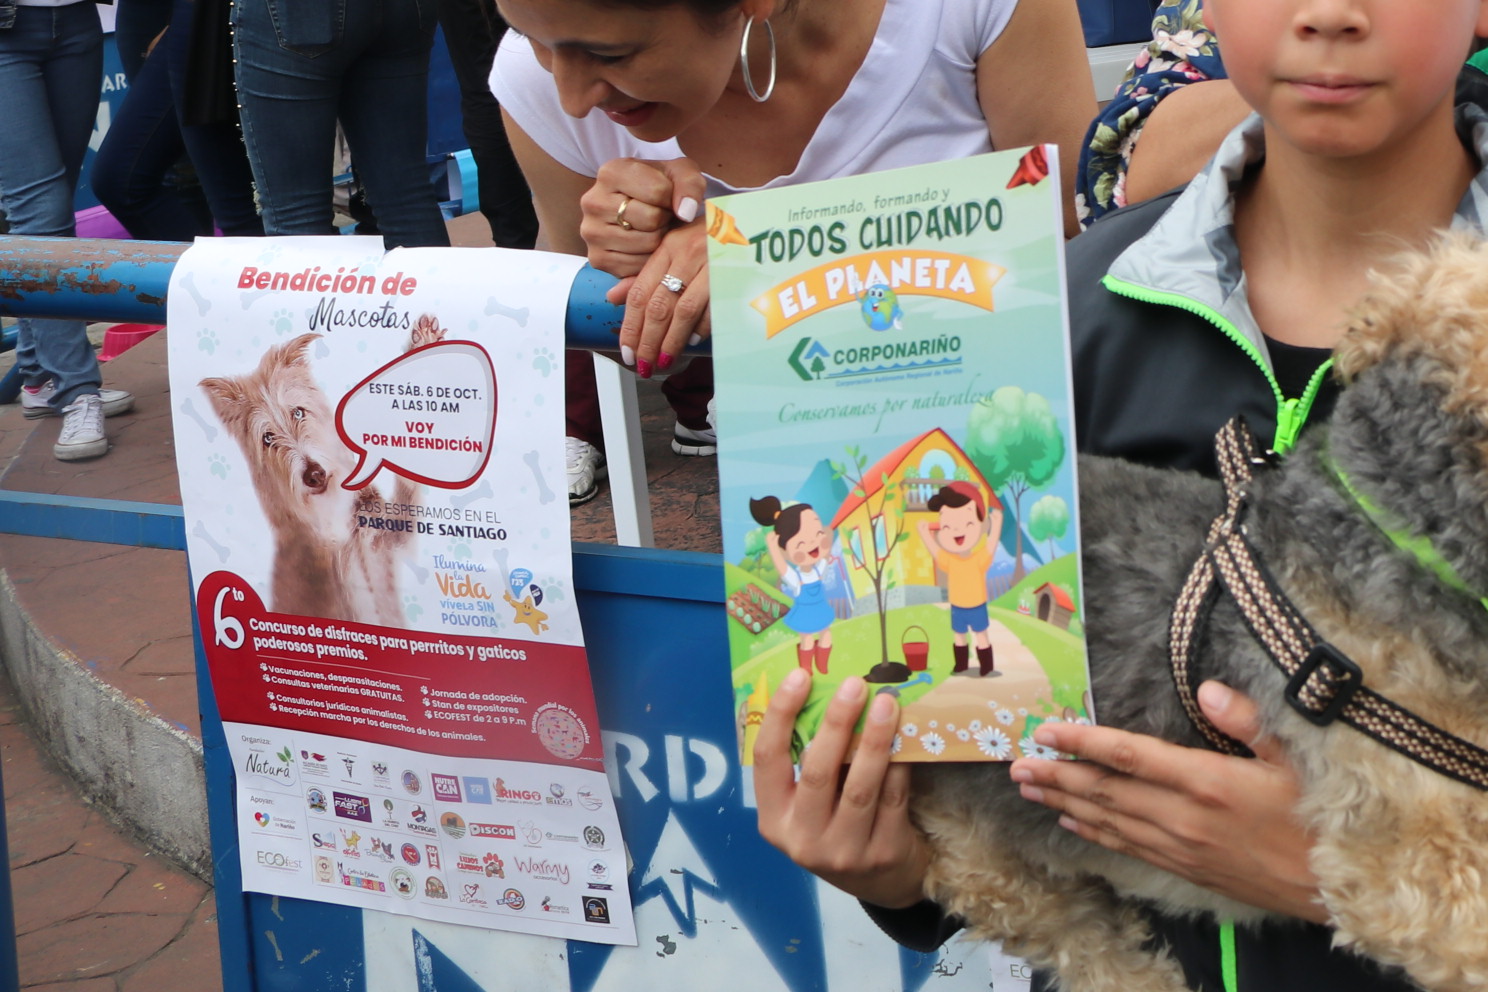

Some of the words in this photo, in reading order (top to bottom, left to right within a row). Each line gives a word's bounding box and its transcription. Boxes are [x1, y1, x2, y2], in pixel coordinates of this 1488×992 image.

[788, 200, 867, 223] Informando,
[873, 189, 938, 210] formando
[941, 188, 951, 203] y
[748, 221, 848, 264] TODOS
[859, 197, 1004, 249] CUIDANDO
[237, 266, 378, 295] Bendición
[381, 272, 418, 296] de
[779, 281, 817, 319] EL
[824, 257, 976, 300] PLANETA
[309, 297, 411, 332] Mascotas
[833, 334, 962, 365] CORPONARIÑO
[369, 383, 396, 396] ESTE
[397, 381, 424, 397] SÁB.
[426, 385, 433, 397] 6
[436, 386, 451, 399] DE
[452, 387, 483, 401] OCT.
[778, 399, 877, 424] Conservamos
[874, 395, 904, 433] por
[911, 373, 995, 411] naturaleza
[391, 400, 400, 410] A
[402, 400, 423, 412] LAS
[426, 401, 438, 412] 10
[441, 401, 460, 413] AM
[405, 421, 434, 434] VOY
[363, 433, 388, 447] POR
[391, 434, 407, 448] MI
[409, 436, 483, 453] BENDICIÓN
[360, 501, 382, 514] LOS
[385, 502, 461, 521] ESPERAMOS
[465, 509, 483, 523] EN
[486, 511, 502, 524] EL
[358, 515, 413, 533] PARQUE
[417, 521, 434, 535] DE
[439, 523, 508, 541] SANTIAGO
[433, 554, 487, 574] Ilumina
[454, 571, 464, 581] la
[435, 572, 492, 600] Vida
[440, 600, 474, 612] vívela
[476, 601, 496, 613] SIN
[441, 611, 498, 628] PÓLVORA
[249, 617, 306, 636] Concurso
[307, 622, 323, 638] de
[325, 624, 378, 646] disfraces
[379, 633, 409, 651] para
[410, 636, 465, 660] perrritos
[465, 645, 475, 661] y
[477, 644, 527, 663] gaticos
[252, 635, 315, 655] poderosos
[316, 642, 368, 662] premios.
[268, 665, 327, 681] Vacunaciones,
[327, 672, 403, 692] desparasitaciones.
[271, 675, 311, 689] Consultas
[311, 681, 360, 696] veterinarias
[360, 688, 405, 703] GRATUITAS.
[276, 693, 325, 708] Consultorios
[325, 700, 361, 713] jurídicos
[361, 706, 409, 722] animalistas.
[430, 688, 467, 700] Jornada
[469, 692, 481, 701] de
[482, 693, 528, 705] adopción.
[432, 699, 452, 709] Stan
[453, 701, 465, 711] de
[466, 703, 519, 715] expositores
[278, 704, 320, 718] Recepción
[320, 711, 352, 723] marcha
[353, 716, 366, 725] por
[367, 717, 379, 727] los
[379, 720, 416, 734] derechos
[416, 726, 427, 735] de
[427, 728, 440, 739] los
[441, 731, 487, 742] animales.
[434, 710, 471, 722] ECOFEST
[472, 714, 485, 723] de
[485, 715, 493, 724] 2
[493, 717, 501, 725] a
[501, 715, 508, 725] 9
[241, 735, 272, 746] Organiza:
[245, 752, 291, 779] Natura
[250, 795, 274, 806] Apoyan:
[435, 783, 459, 796] CAN
[501, 788, 542, 802] RINGO
